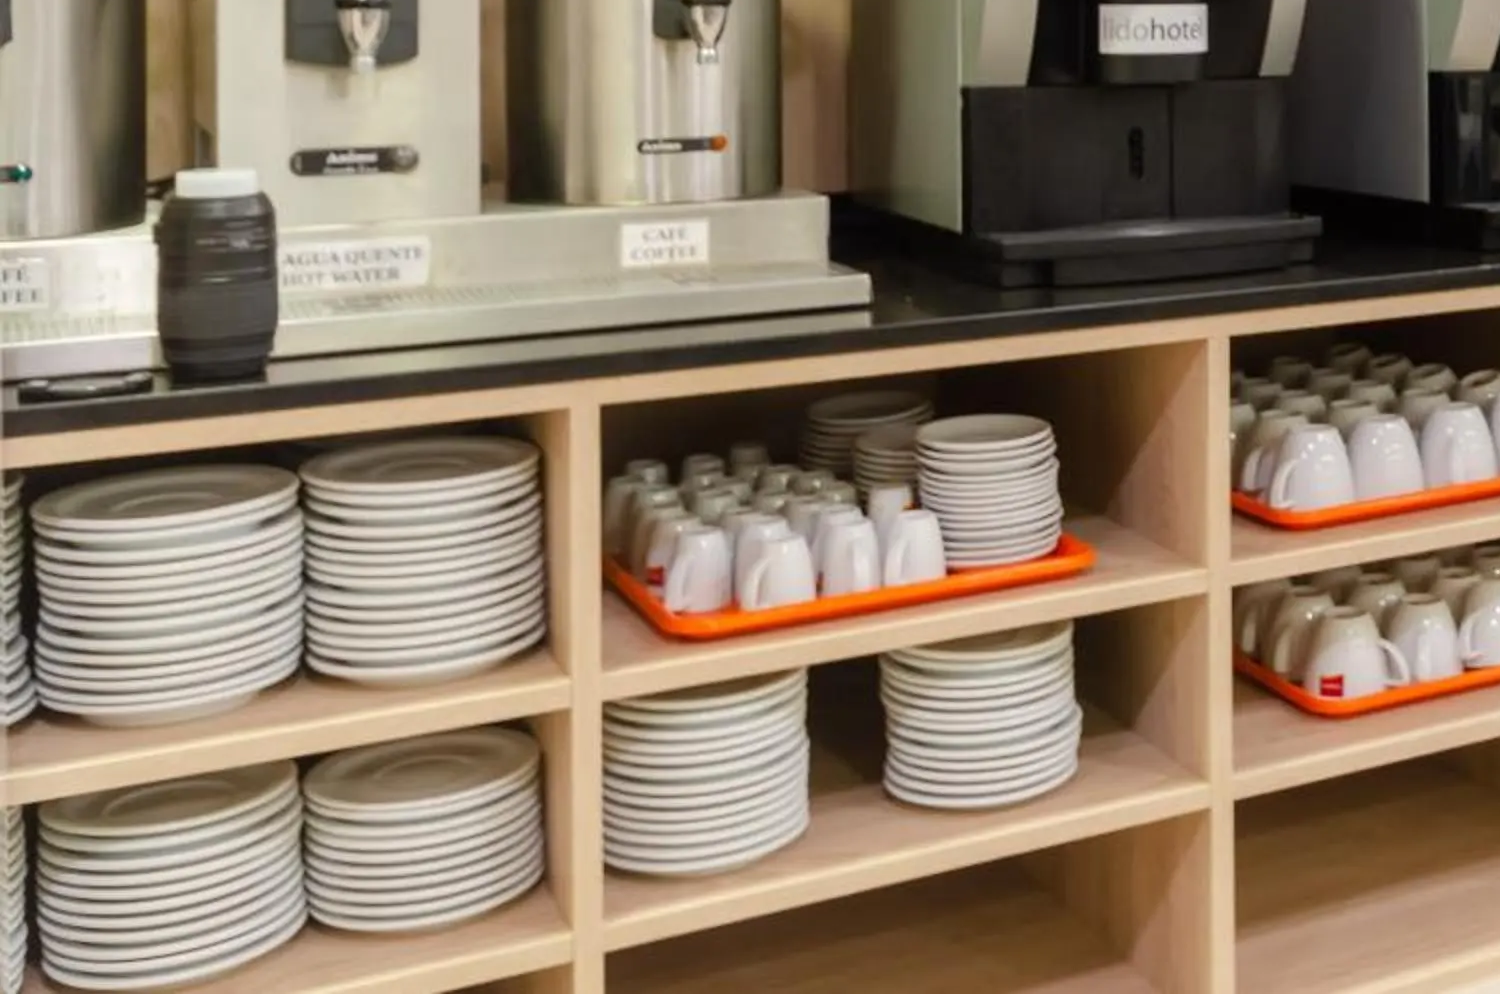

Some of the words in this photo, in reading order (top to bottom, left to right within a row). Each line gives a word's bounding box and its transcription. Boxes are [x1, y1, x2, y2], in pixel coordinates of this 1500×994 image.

[1102, 15, 1205, 42] lidohotel
[282, 250, 342, 267] AGUA
[344, 245, 423, 266] QUENTE
[629, 245, 697, 261] COFFEE
[282, 272, 326, 287] HOT
[331, 267, 401, 284] WATER
